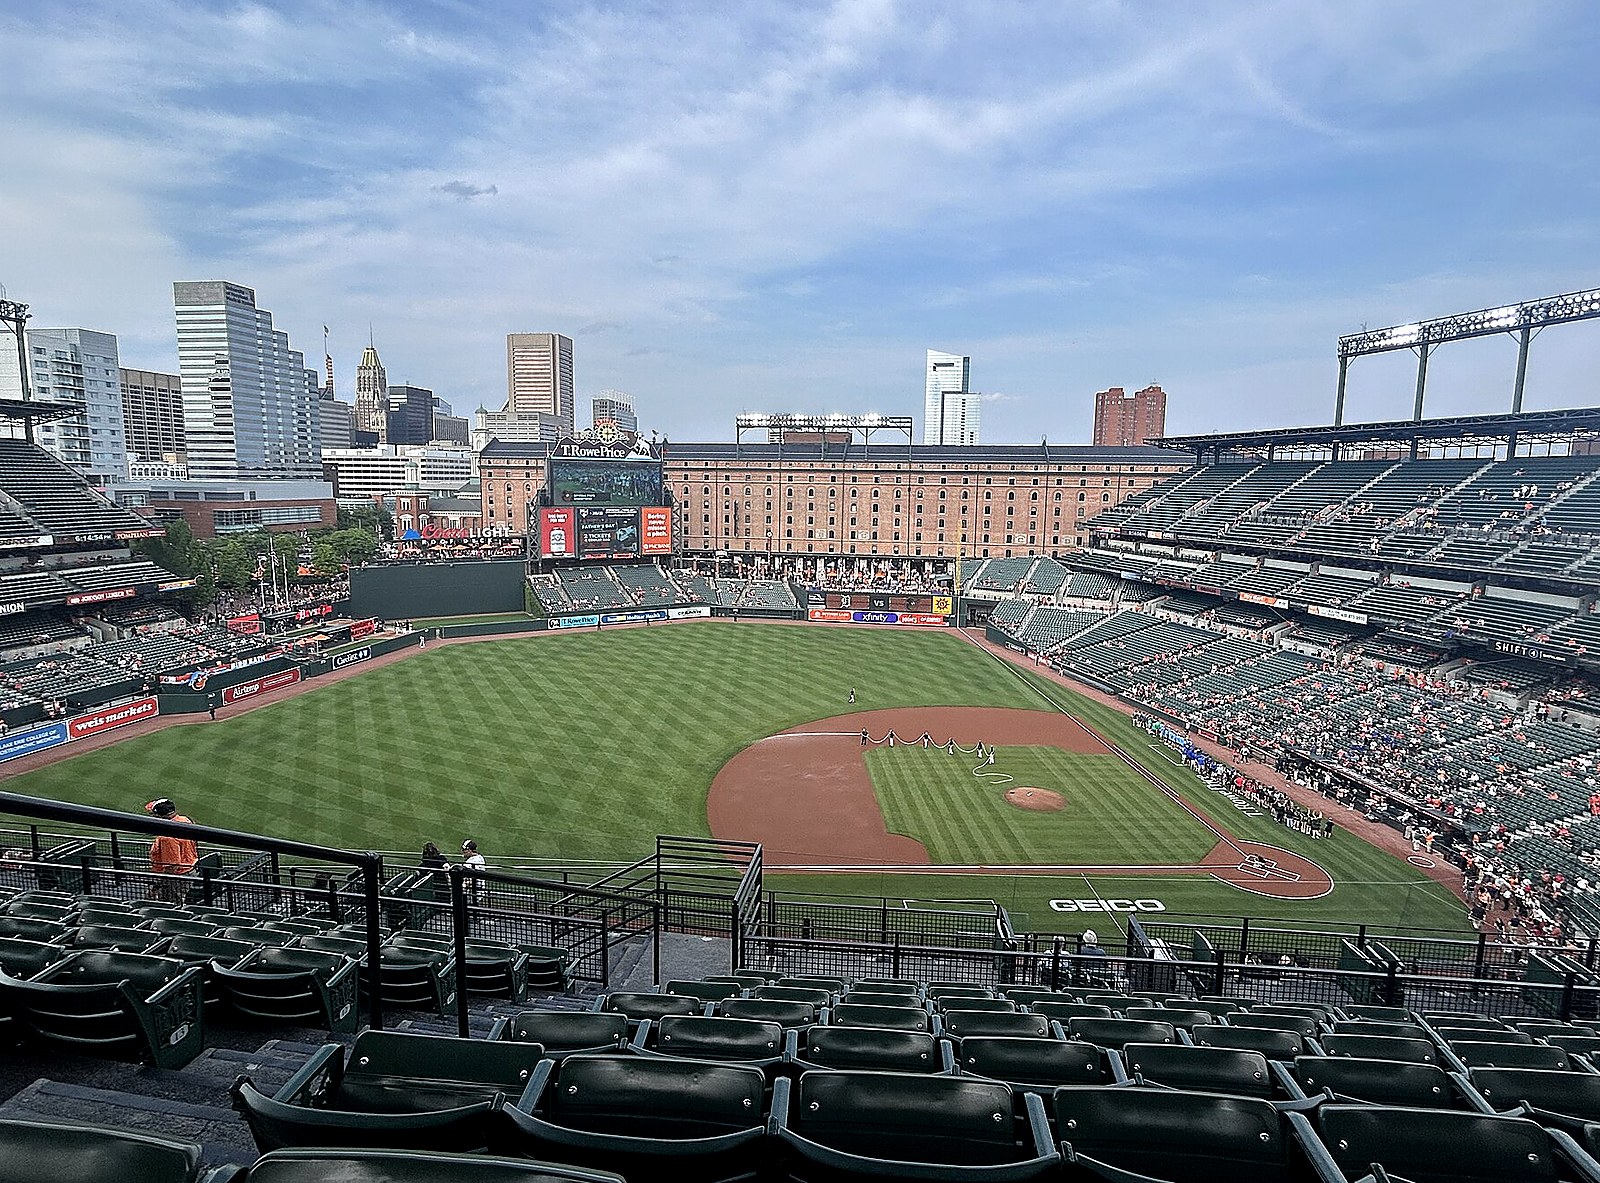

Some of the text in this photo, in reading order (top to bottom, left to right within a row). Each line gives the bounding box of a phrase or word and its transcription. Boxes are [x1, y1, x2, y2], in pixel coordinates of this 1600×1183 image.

[571, 445, 598, 457] Rowe
[600, 445, 626, 458] Price
[469, 527, 511, 538] LIGHT
[862, 613, 888, 622] xfinity
[1495, 641, 1528, 656] SHIFT
[75, 703, 153, 732] weis markets
[26, 731, 49, 742] COLLEGE
[1048, 899, 1166, 912] GEICO
